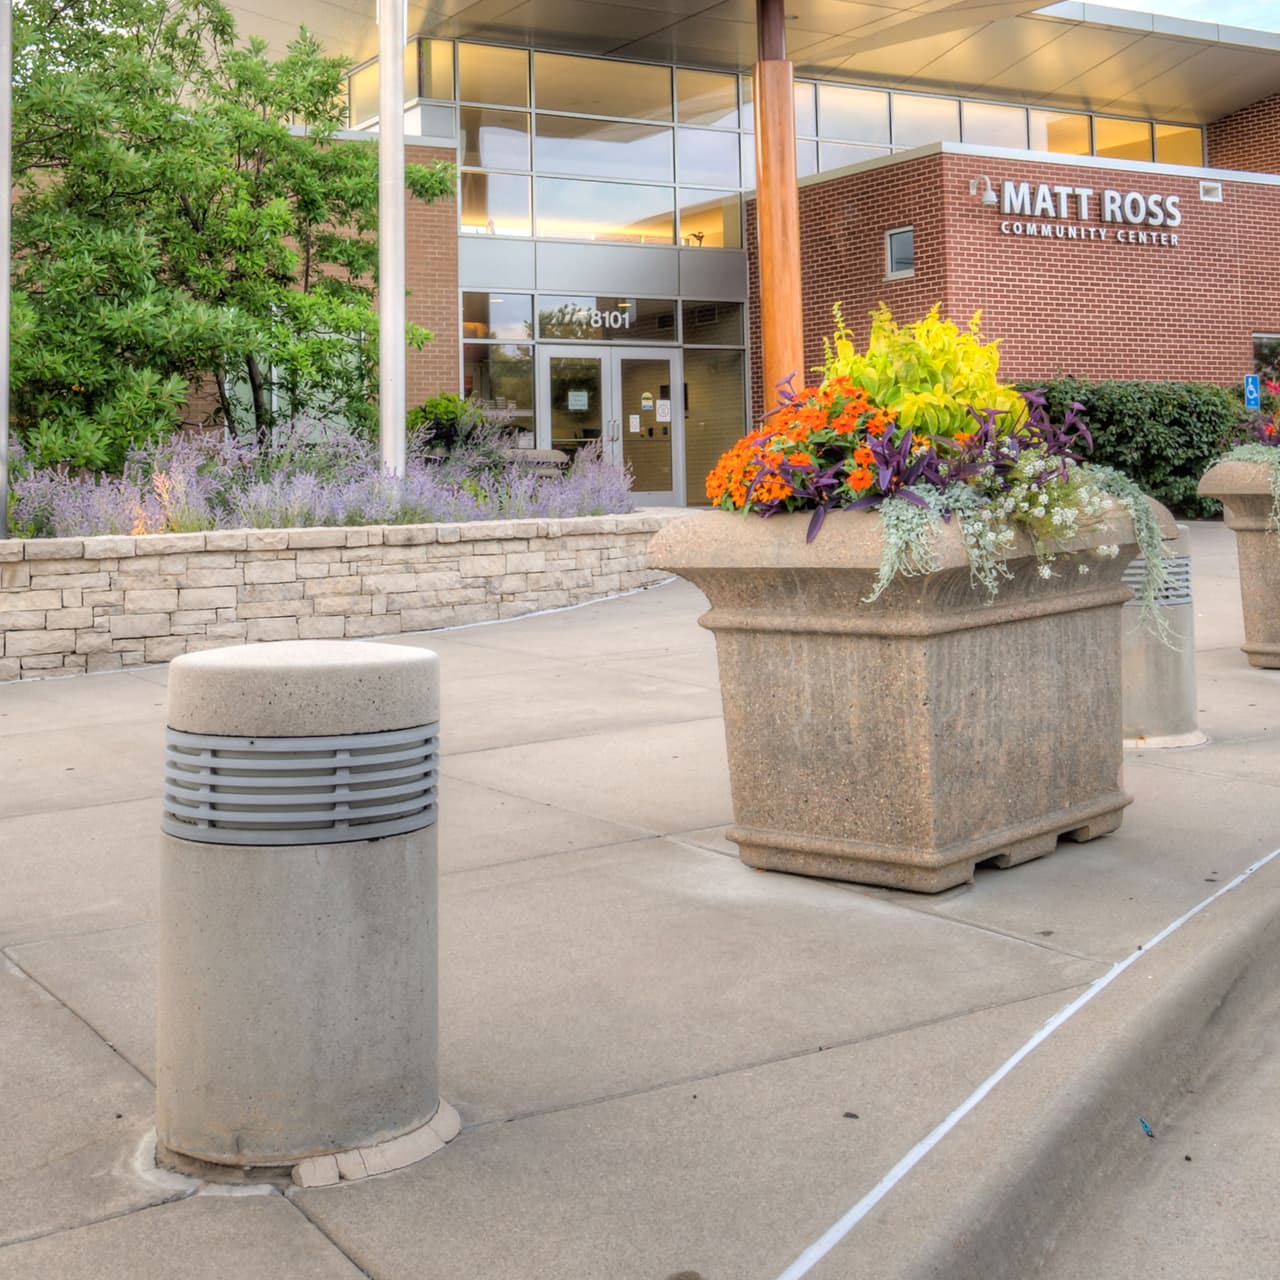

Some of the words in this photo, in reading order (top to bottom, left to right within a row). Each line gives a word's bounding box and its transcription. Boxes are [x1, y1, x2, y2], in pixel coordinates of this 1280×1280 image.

[1001, 180, 1094, 220] MATT
[1102, 189, 1182, 227] ROSS
[1001, 221, 1107, 241] COMMUNITY
[1117, 229, 1179, 246] CENTER
[590, 310, 630, 329] 8101
